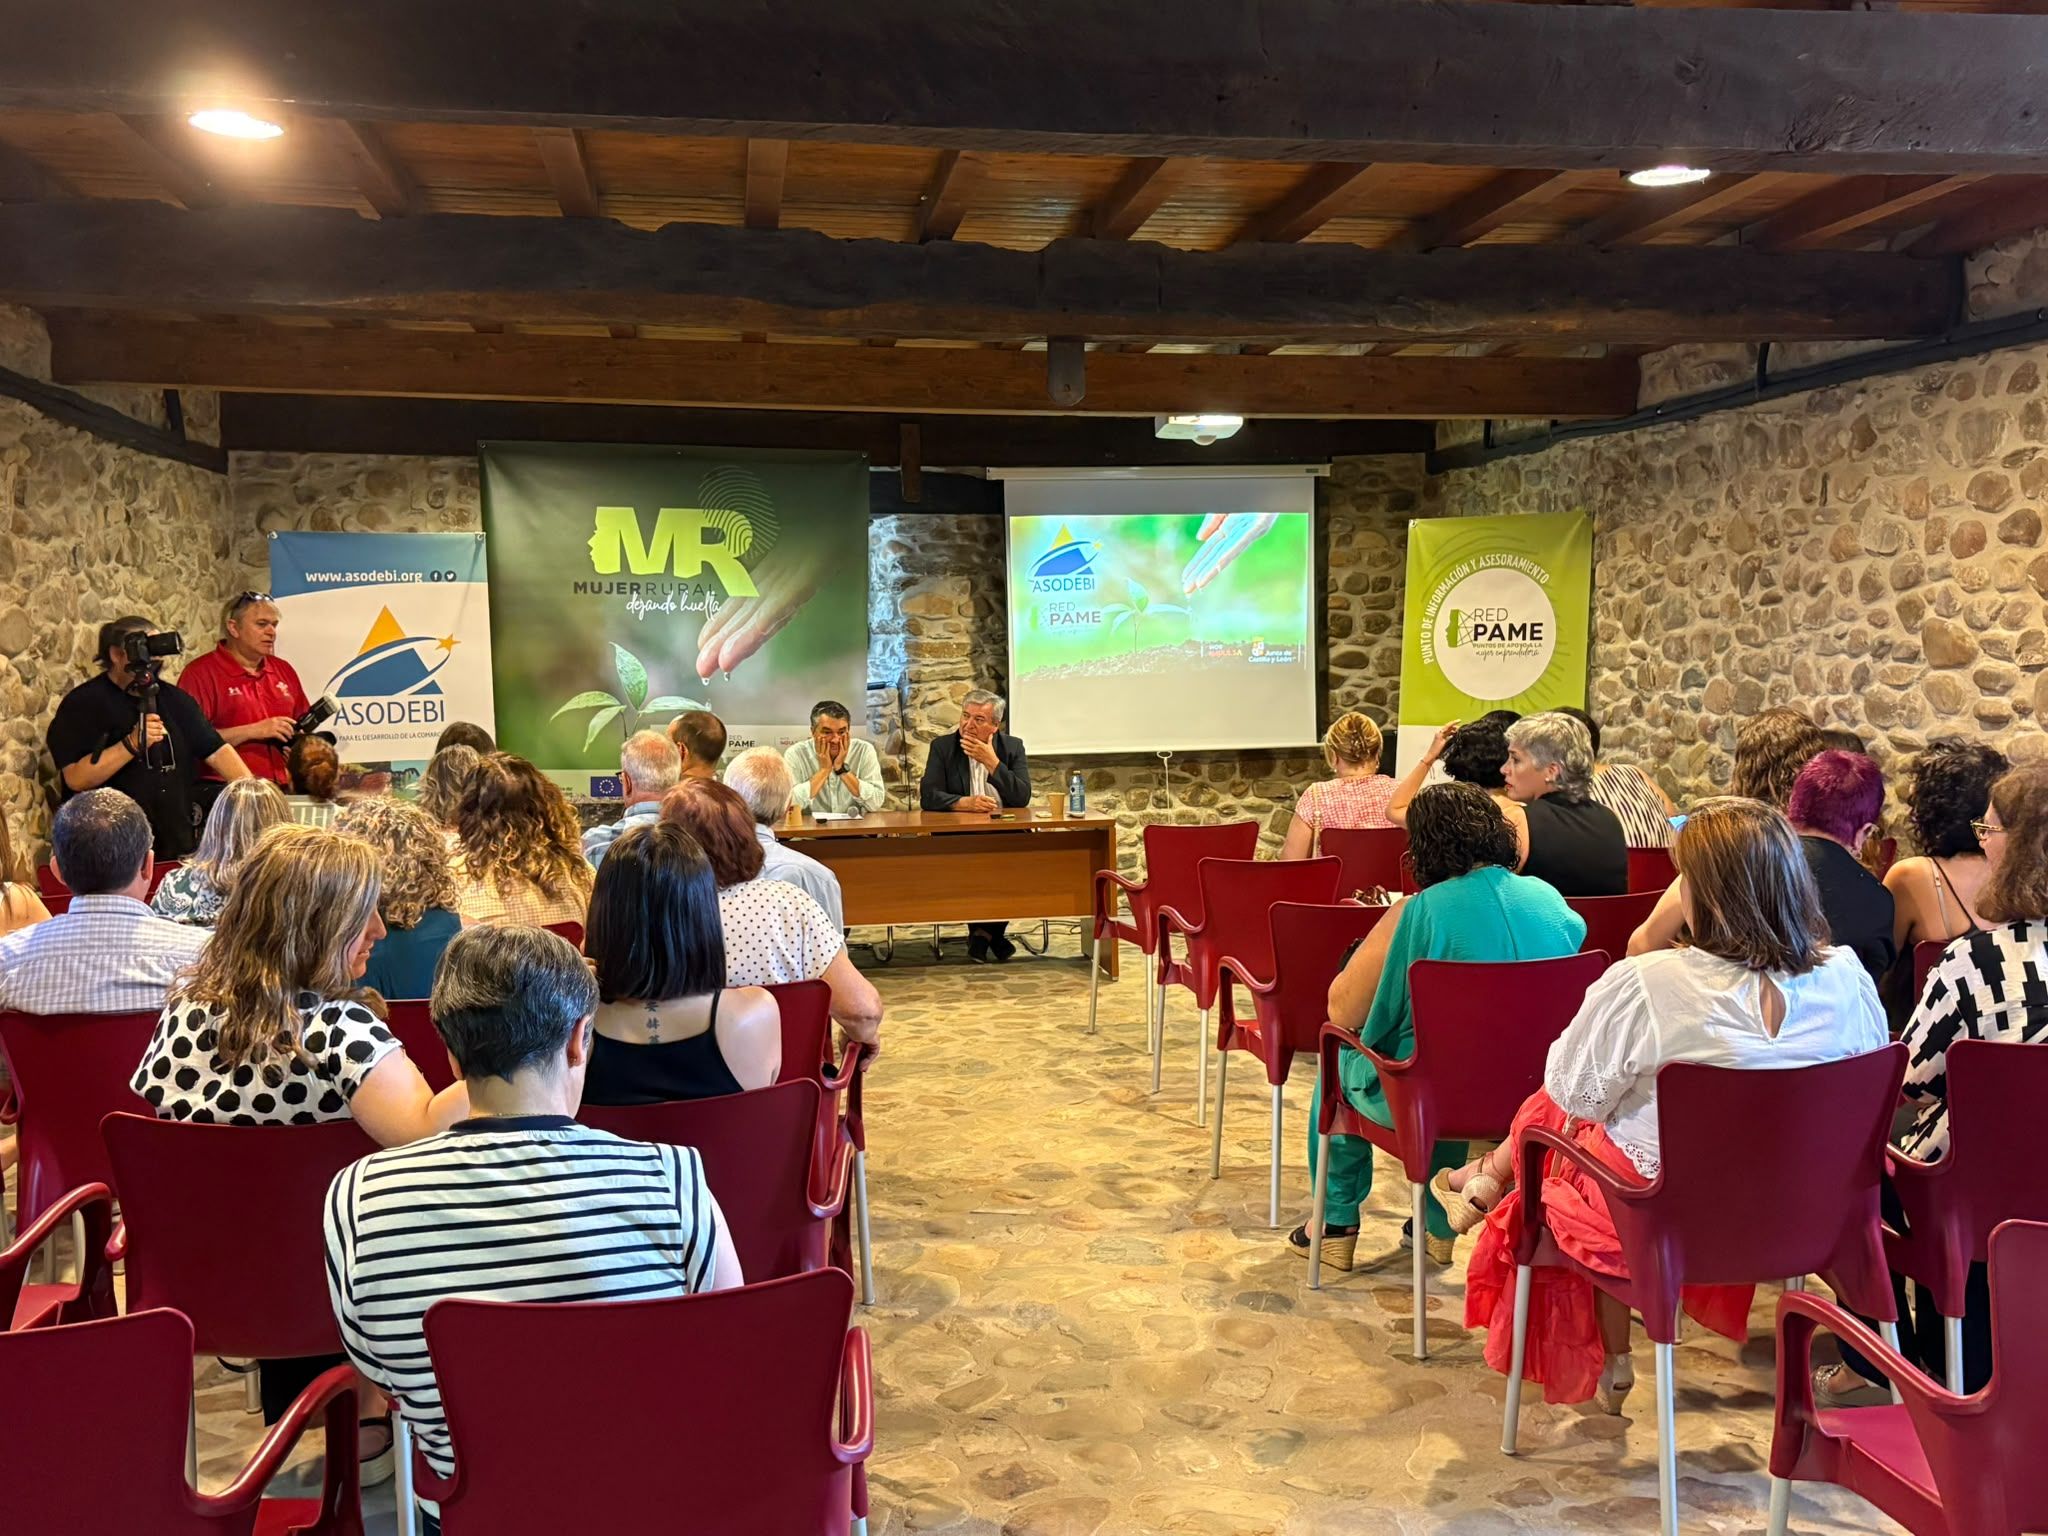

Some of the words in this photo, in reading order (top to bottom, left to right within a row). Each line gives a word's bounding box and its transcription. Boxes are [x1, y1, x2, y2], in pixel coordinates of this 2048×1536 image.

[587, 506, 760, 598] MR
[1469, 558, 1477, 570] Y
[1479, 553, 1550, 585] ASESORAMIENTO
[305, 569, 423, 584] www.asodebi.org
[1032, 577, 1096, 593] ASODEBI
[1425, 564, 1471, 617] INFORMACIÓN
[626, 590, 677, 621] dejando
[680, 590, 722, 622] huella
[1049, 601, 1076, 613] RED
[1049, 611, 1102, 626] PAME
[1473, 607, 1509, 622] RED
[1421, 617, 1434, 629] DE
[1473, 622, 1544, 641] PAME
[1420, 632, 1434, 665] PUNTO
[333, 699, 445, 726] ASODEBI
[362, 733, 399, 741] DESARROLLO
